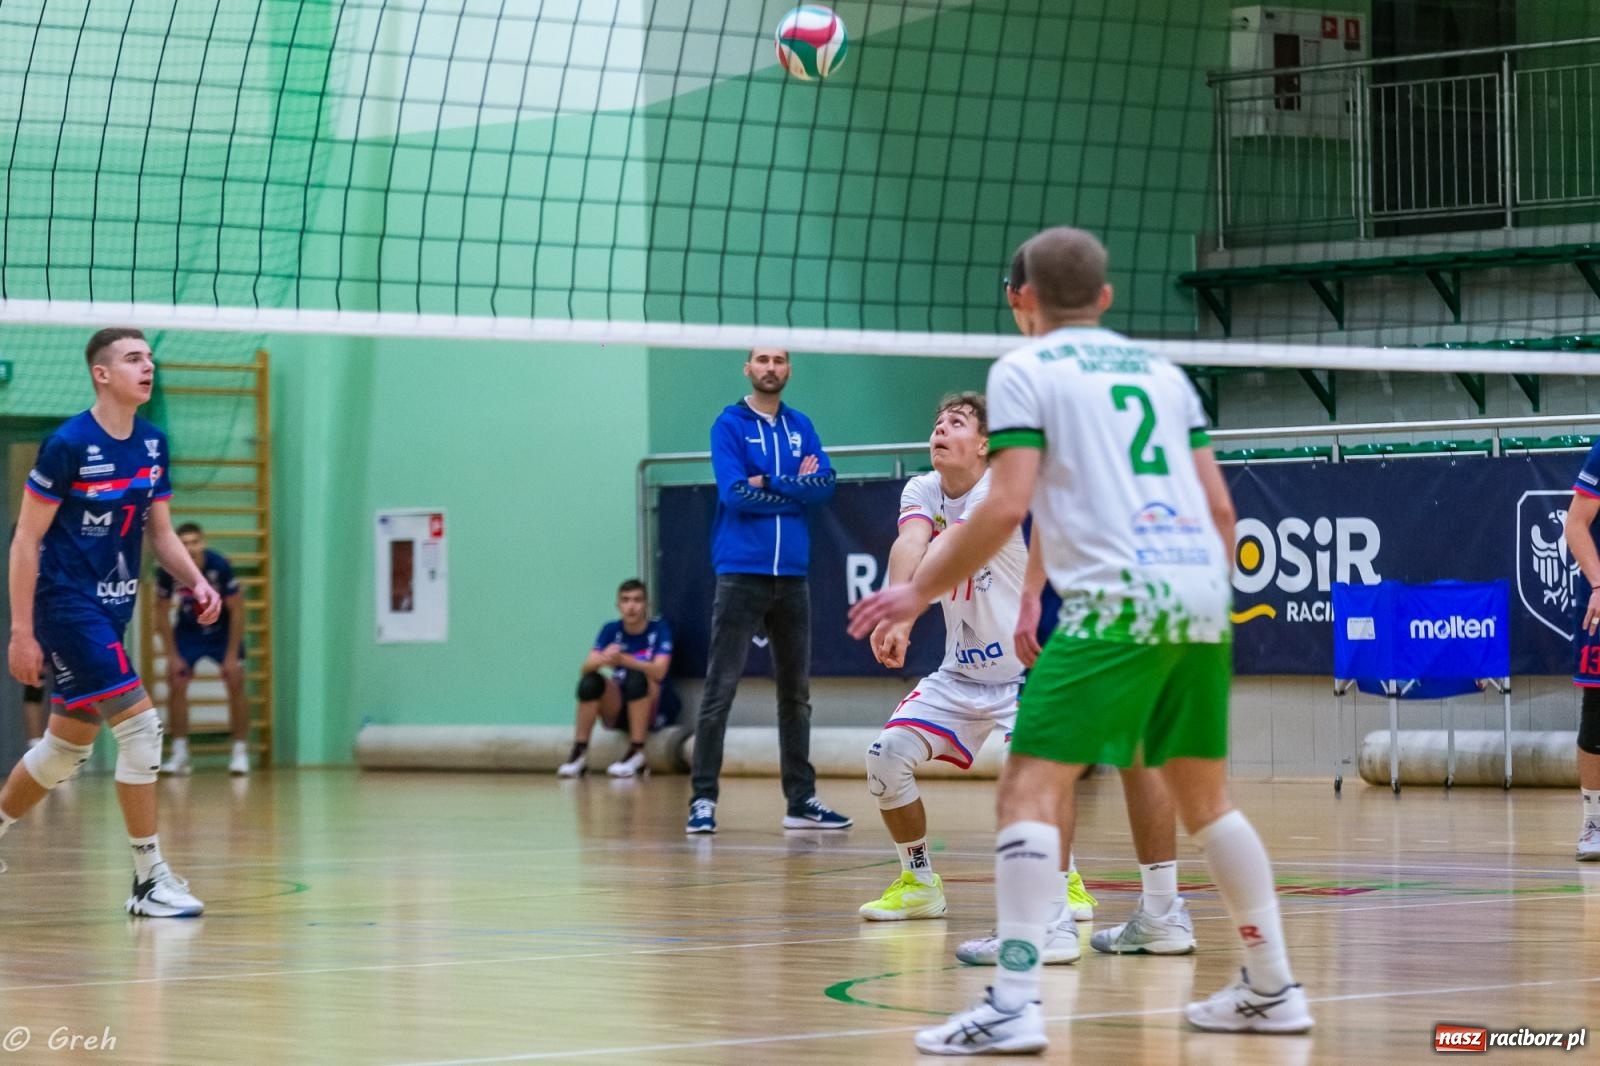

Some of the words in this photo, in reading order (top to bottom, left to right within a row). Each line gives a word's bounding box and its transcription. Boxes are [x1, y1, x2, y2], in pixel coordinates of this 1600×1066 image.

[1109, 384, 1169, 476] 2
[121, 504, 136, 537] 7
[1287, 601, 1335, 622] RACI
[1410, 616, 1496, 639] molten
[1580, 645, 1600, 675] 13
[912, 846, 926, 869] MKS
